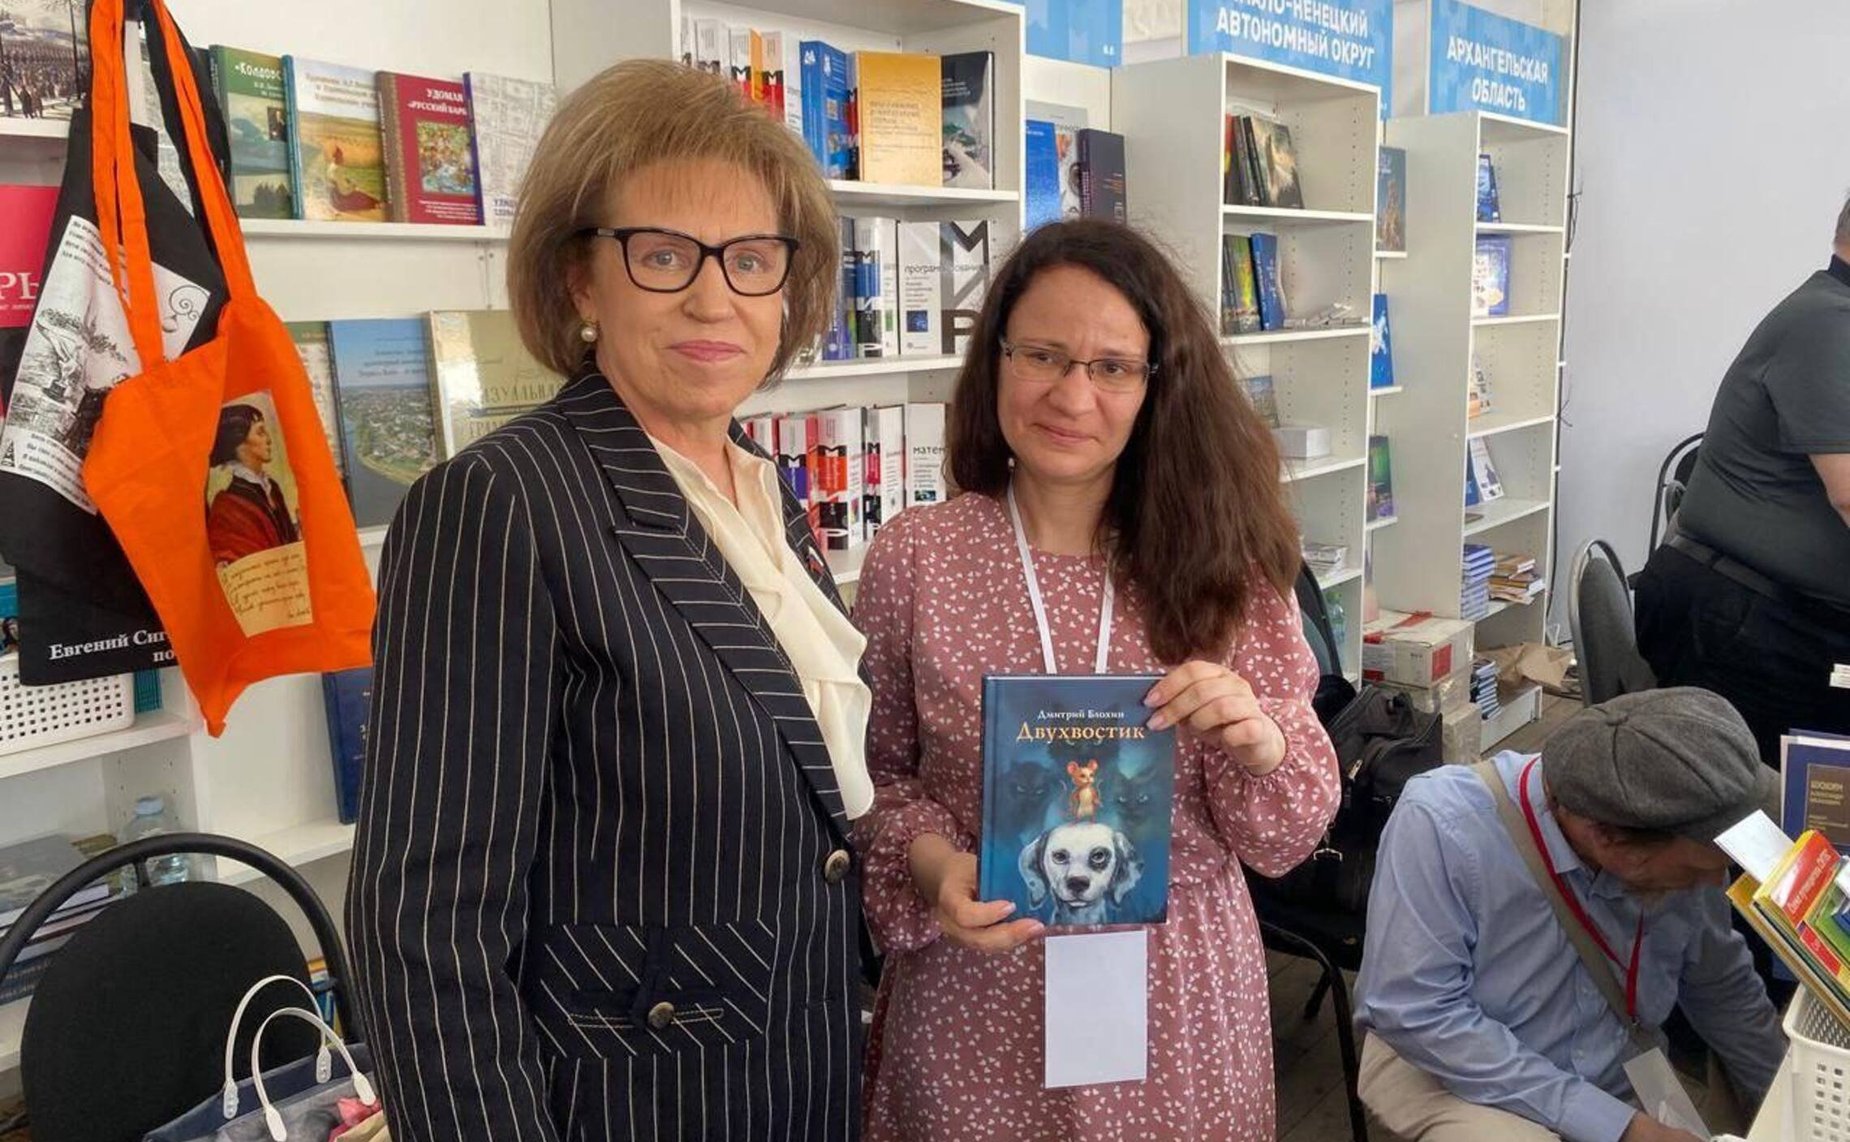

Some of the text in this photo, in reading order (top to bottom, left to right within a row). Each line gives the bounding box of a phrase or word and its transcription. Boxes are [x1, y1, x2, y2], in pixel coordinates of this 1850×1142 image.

[1234, 0, 1369, 38] ЛО-НЕНЕЦКИЙ
[1215, 6, 1375, 70] АВТОНОМНЫЙ ОКРУГ
[1446, 34, 1549, 86] АРХАНГЕЛЬСКАЯ
[1471, 76, 1526, 112] ОБЛАСТЬ
[49, 632, 130, 661] Евгений
[1015, 720, 1146, 745] Двухвостик
[1037, 709, 1125, 721] Дмитрий Блохин
